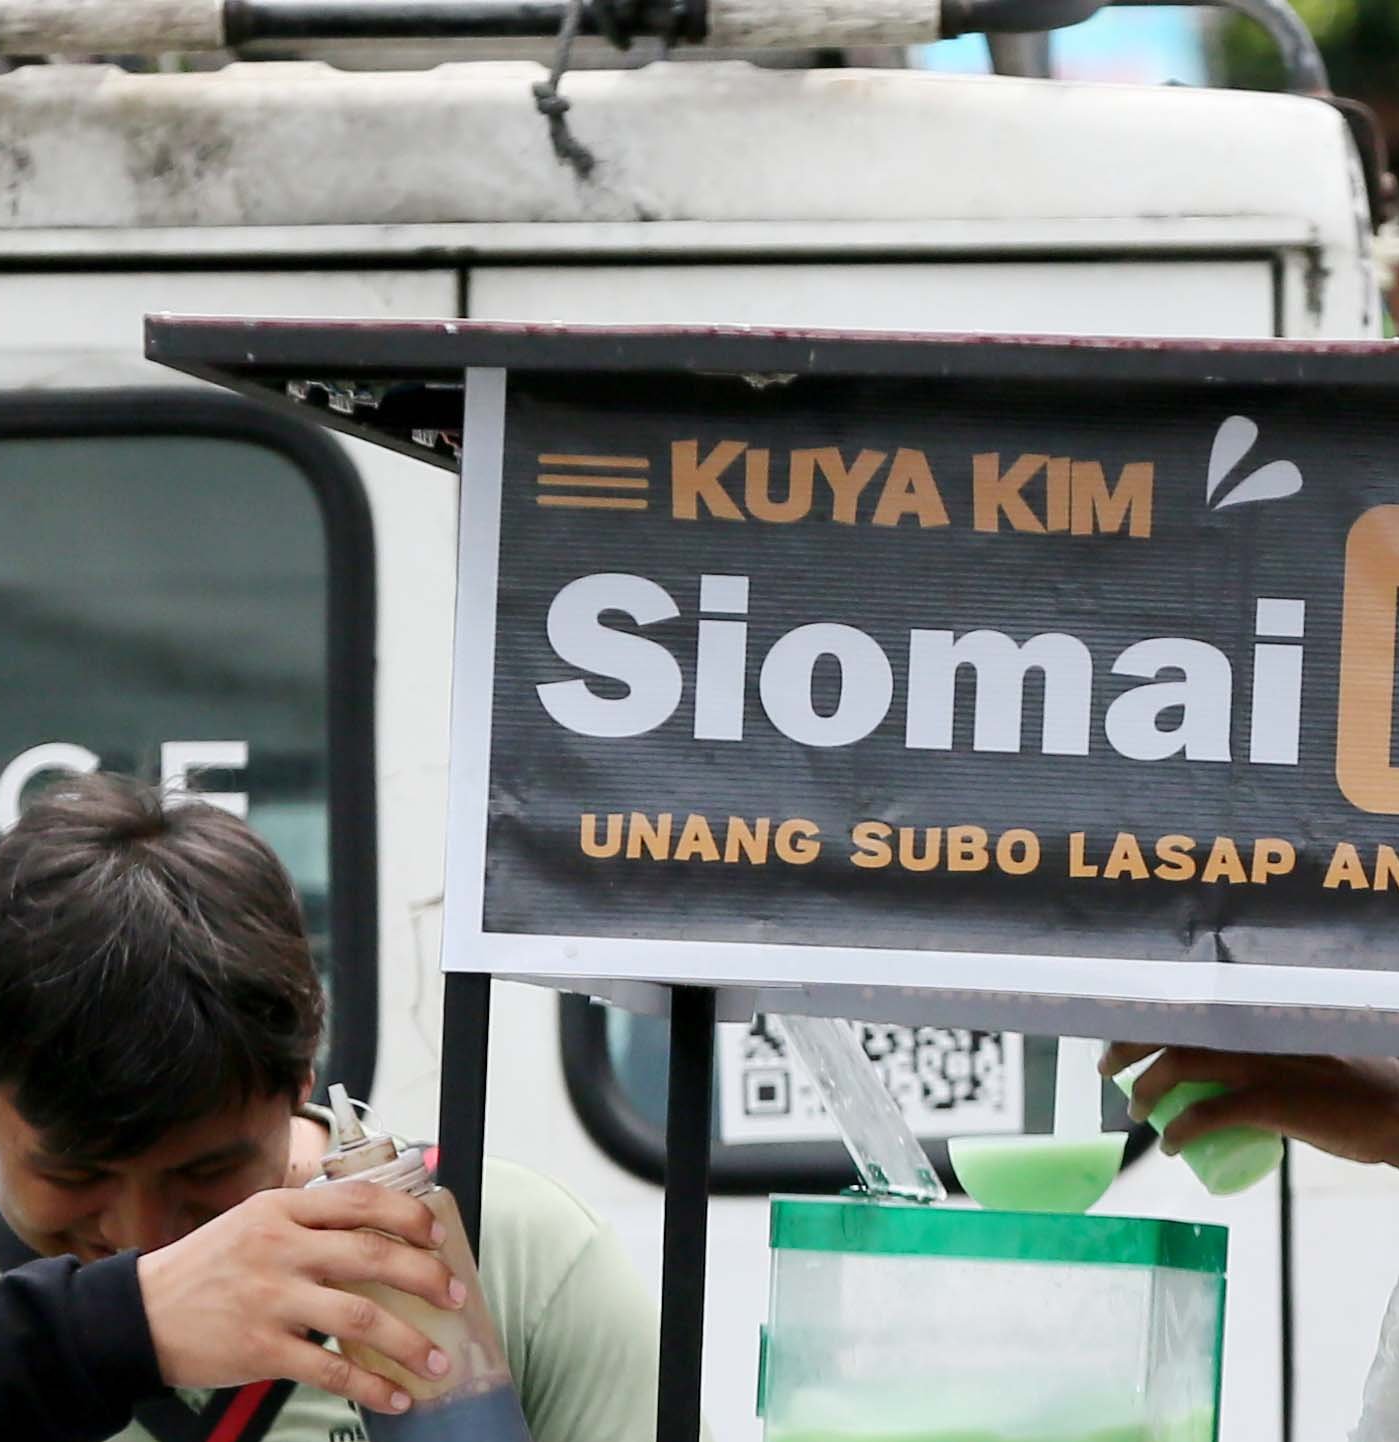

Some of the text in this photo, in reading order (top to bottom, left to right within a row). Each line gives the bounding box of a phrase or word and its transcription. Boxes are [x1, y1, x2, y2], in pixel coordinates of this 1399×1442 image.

[671, 438, 1154, 539] KUYA KIM
[535, 572, 1306, 766] Siomai
[580, 812, 822, 867] UNANG
[850, 820, 1042, 877] SUBO
[1068, 830, 1297, 886] LASAP
